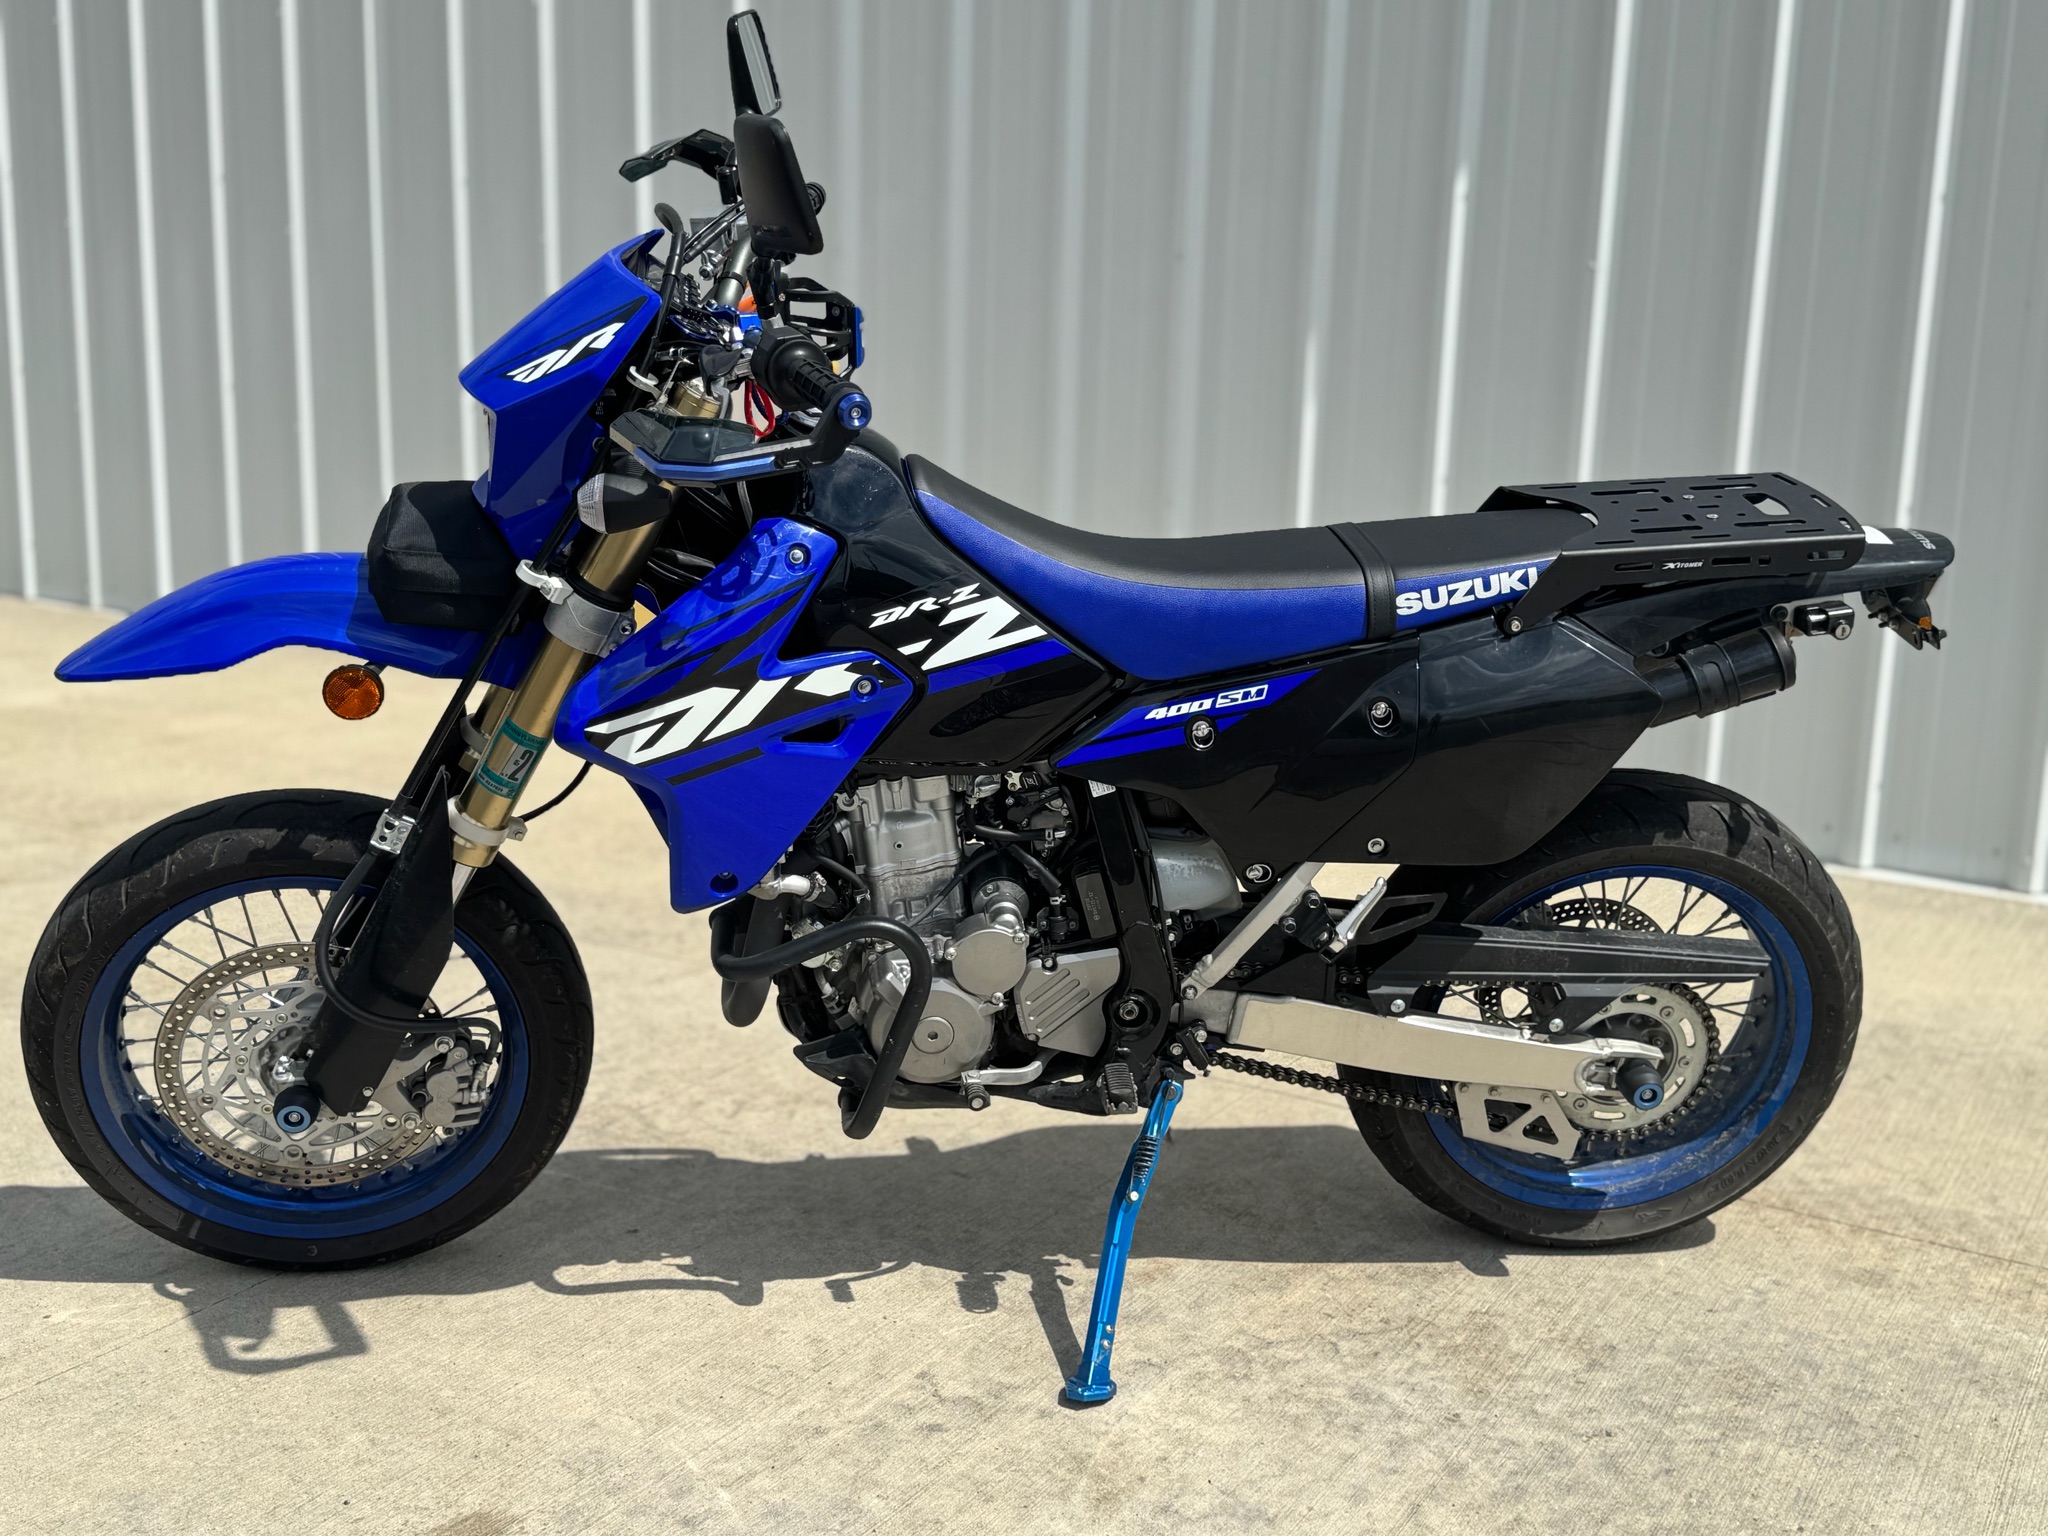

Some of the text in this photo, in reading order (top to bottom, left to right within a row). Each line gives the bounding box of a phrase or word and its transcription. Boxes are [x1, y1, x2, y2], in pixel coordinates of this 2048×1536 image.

[868, 582, 981, 629] DR-Z
[1395, 566, 1539, 616] SUZUKI
[1144, 685, 1268, 720] 400 SM
[508, 749, 535, 782] 2
